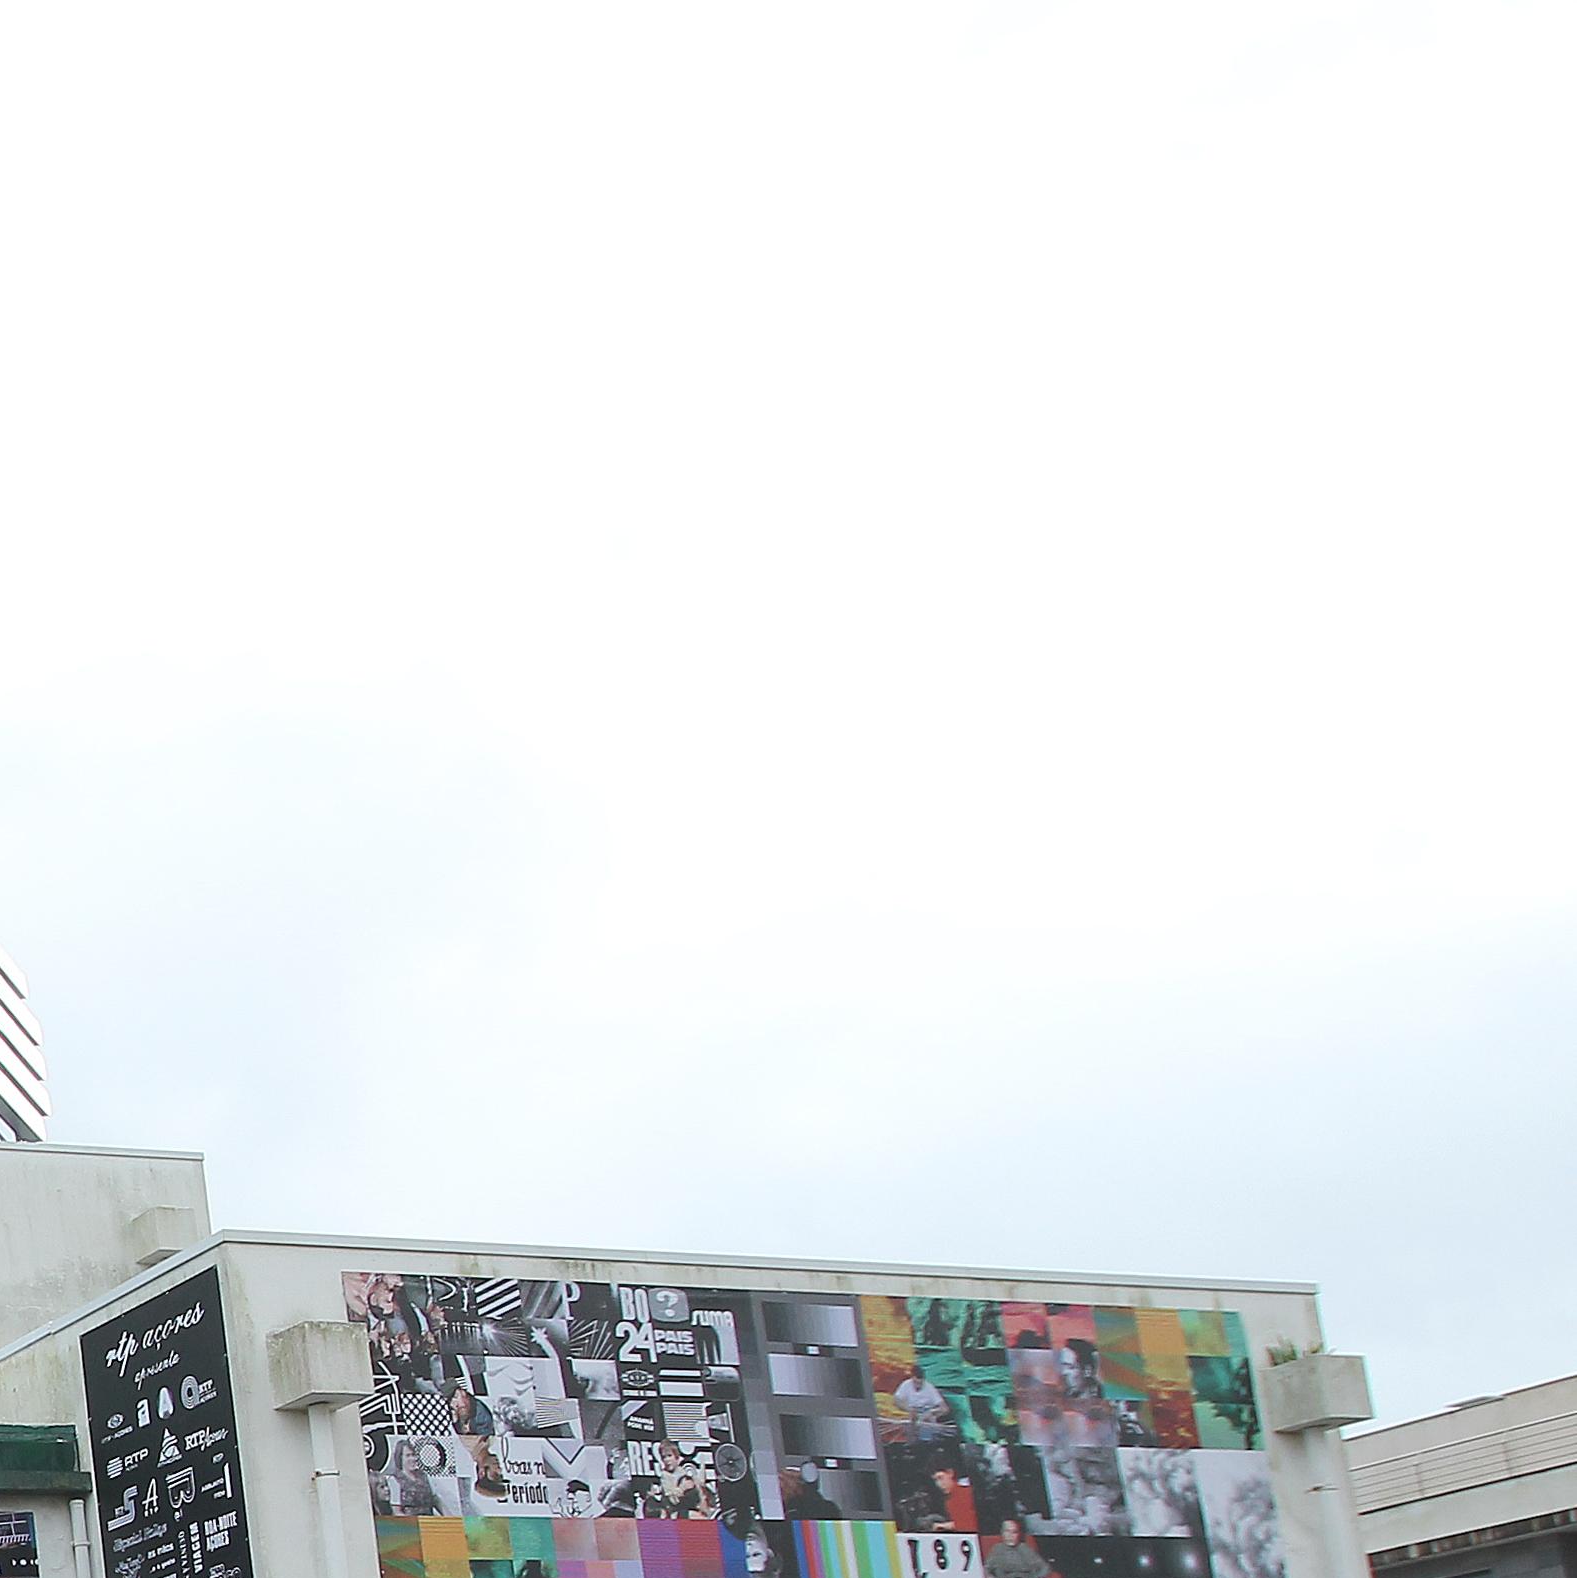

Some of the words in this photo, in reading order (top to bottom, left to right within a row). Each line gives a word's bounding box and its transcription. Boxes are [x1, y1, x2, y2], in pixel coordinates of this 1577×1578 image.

[614, 1320, 658, 1363] 24
[653, 1329, 694, 1343] PAIS
[656, 1342, 696, 1356] PAIS
[124, 1448, 149, 1467] RTP
[934, 1539, 949, 1570] 8
[960, 1540, 973, 1571] 9
